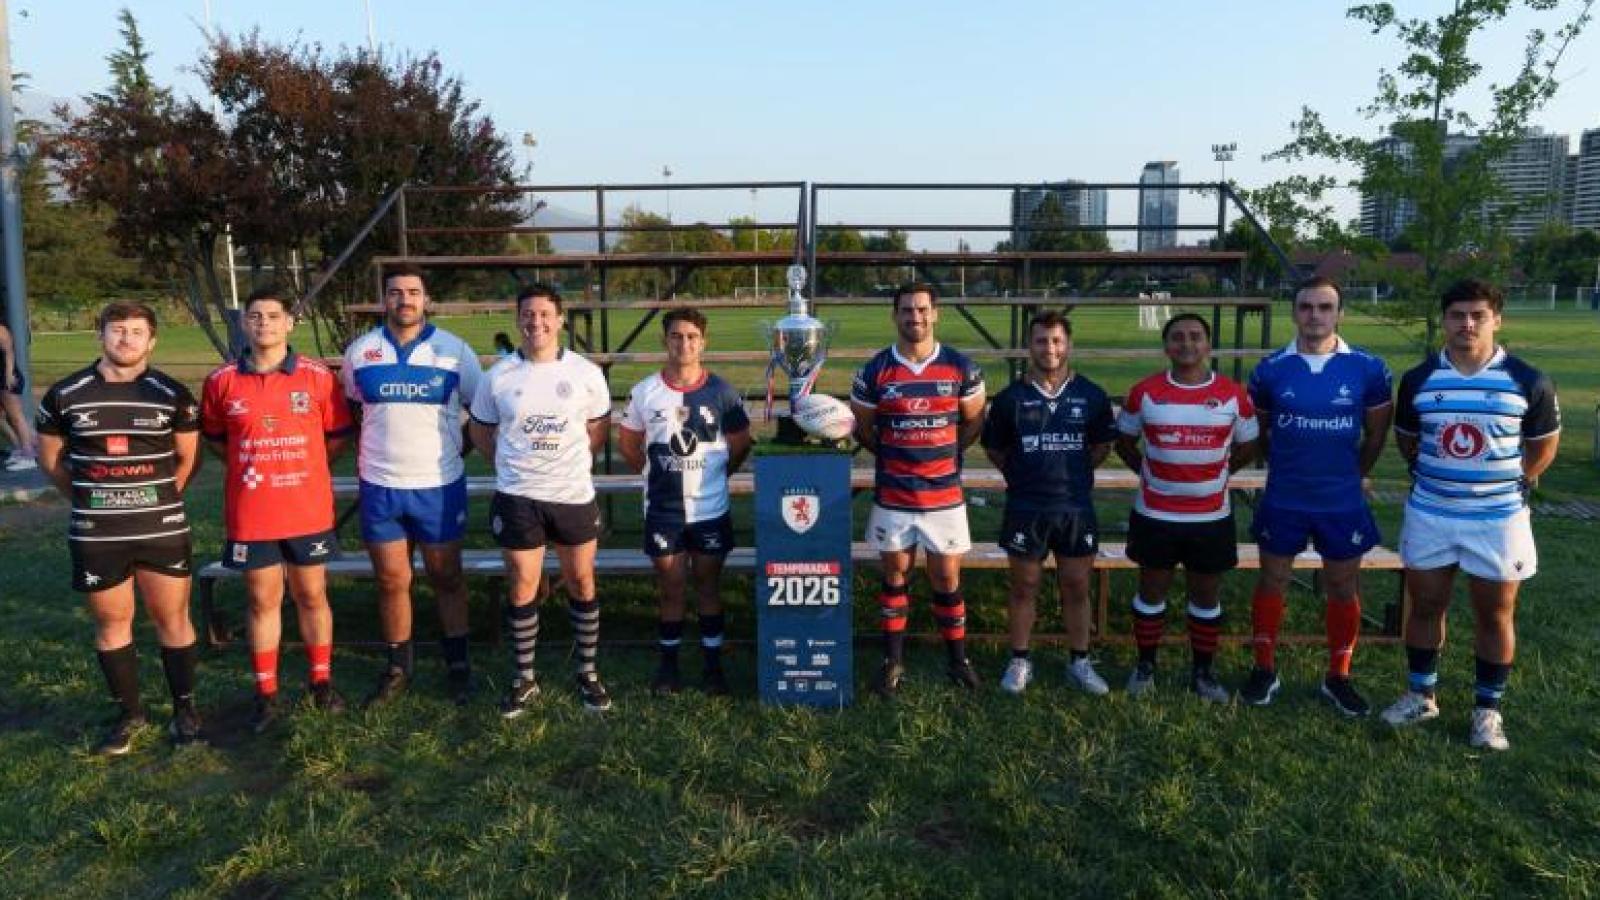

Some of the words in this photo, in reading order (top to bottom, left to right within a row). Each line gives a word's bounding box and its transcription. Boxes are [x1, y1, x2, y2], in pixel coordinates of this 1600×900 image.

[380, 383, 429, 398] cmpc
[522, 415, 568, 434] Ford
[892, 416, 949, 428] LEXUS
[771, 563, 830, 574] TEMPORADA
[767, 576, 840, 606] 2026
